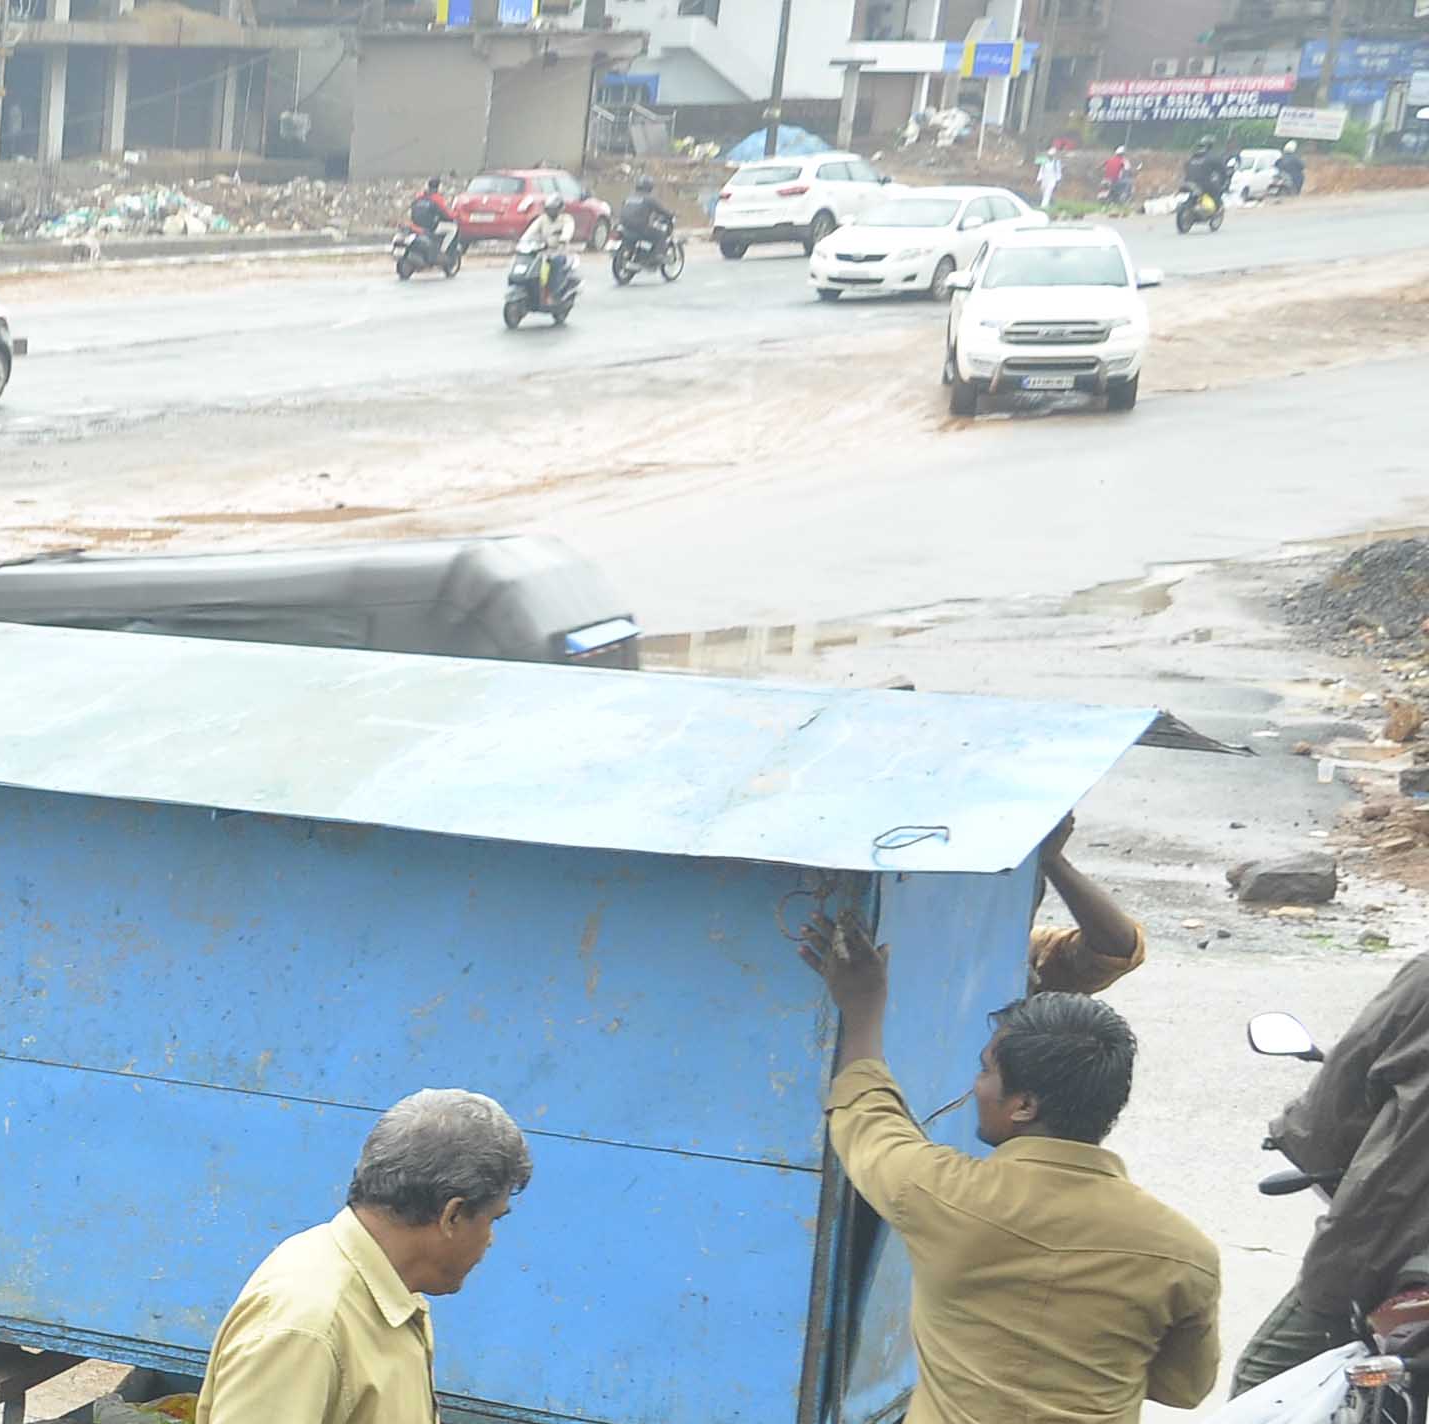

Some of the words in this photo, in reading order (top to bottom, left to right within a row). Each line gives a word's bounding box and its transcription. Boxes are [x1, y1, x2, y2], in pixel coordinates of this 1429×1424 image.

[1128, 78, 1206, 94] EDUCATIONAL
[1208, 76, 1286, 92] INSTITUTION
[1109, 94, 1161, 108] DIRECT
[1226, 91, 1259, 105] PUC
[1216, 103, 1280, 118] ABACUS
